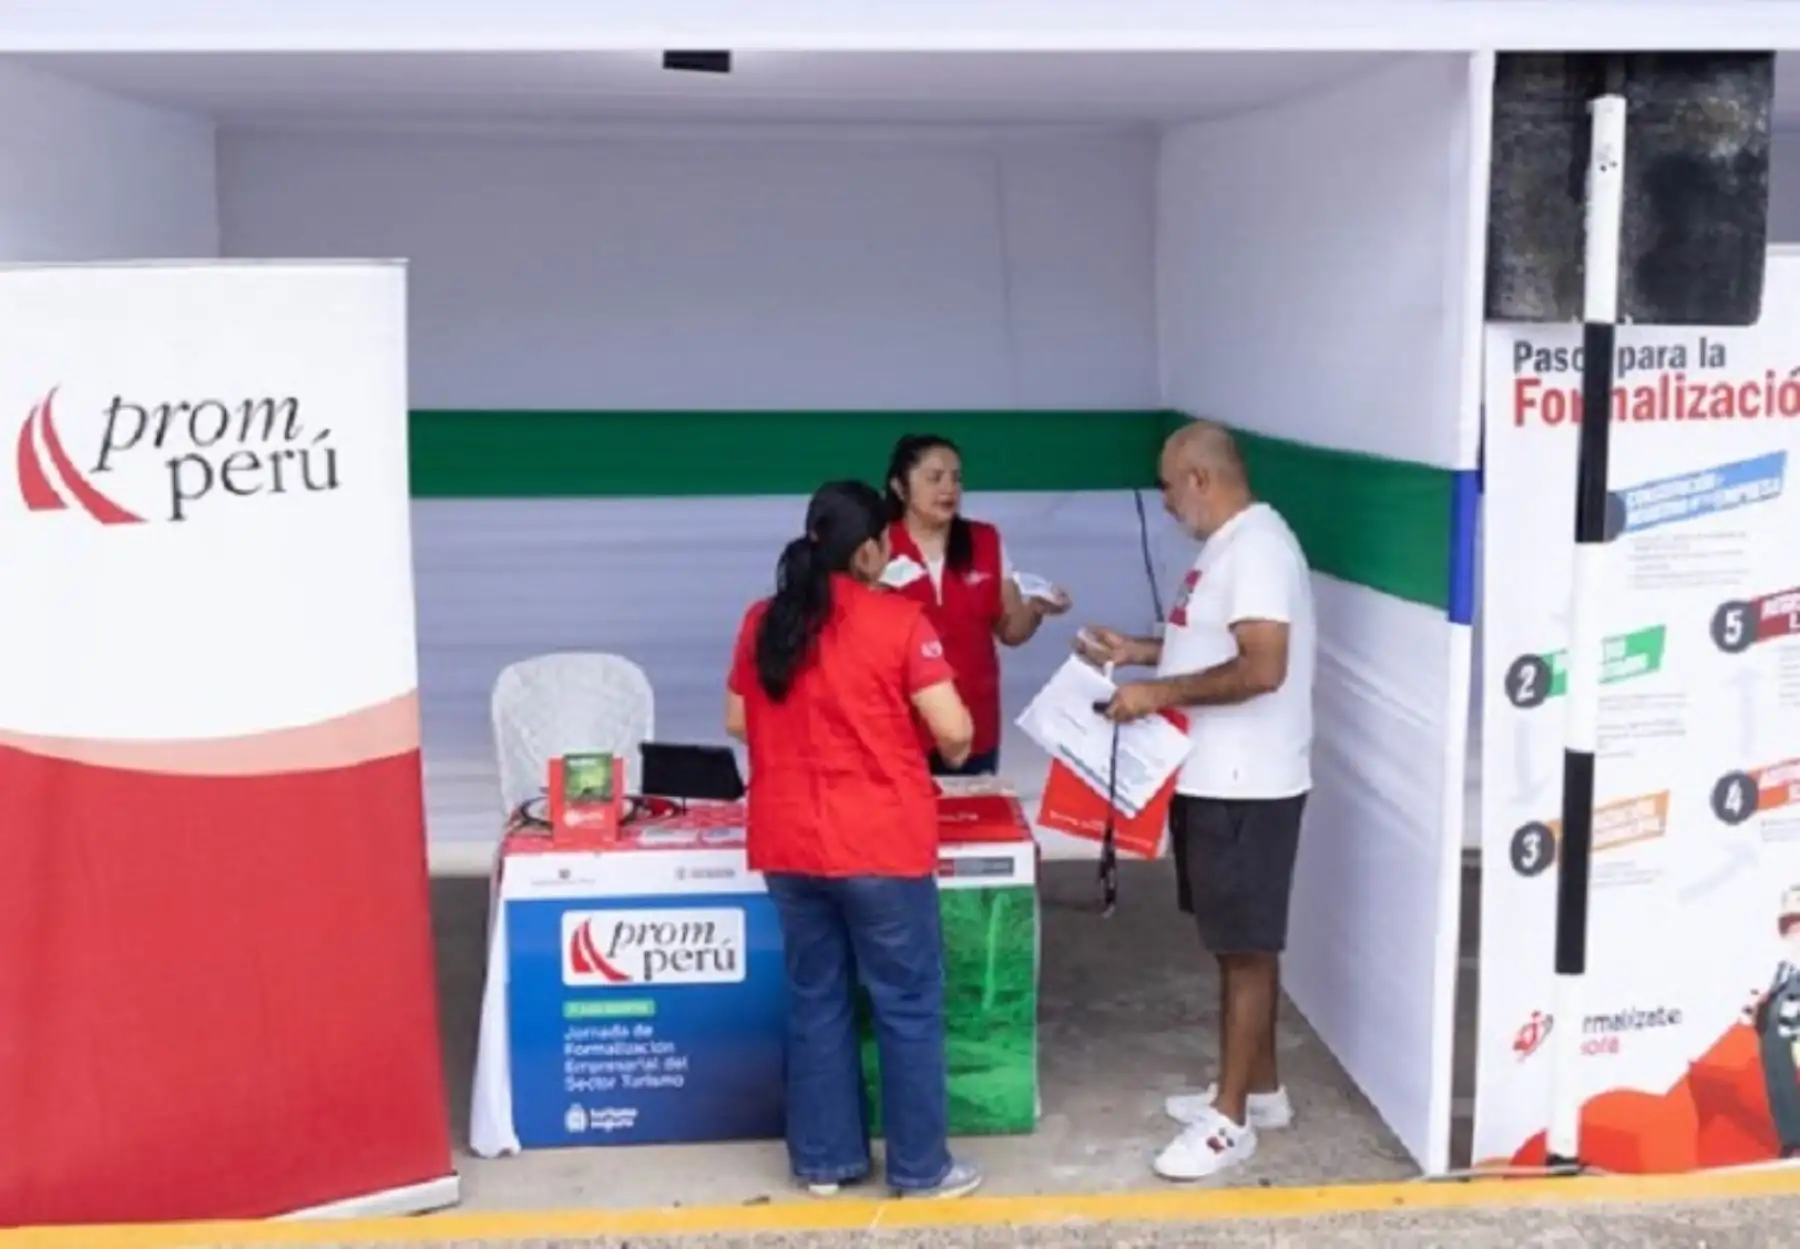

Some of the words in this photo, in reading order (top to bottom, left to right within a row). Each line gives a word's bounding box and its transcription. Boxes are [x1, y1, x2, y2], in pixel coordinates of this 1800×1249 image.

[1513, 339, 1584, 374] Paso
[1618, 345, 1687, 379] para
[1699, 337, 1726, 369] la
[88, 395, 303, 474] prom
[164, 428, 341, 522] perú
[1724, 608, 1744, 645] 5
[1516, 663, 1538, 704] 2
[1724, 779, 1742, 816] 4
[1521, 831, 1542, 869] 3
[606, 920, 716, 959] prom
[643, 938, 737, 982] perú
[632, 1023, 654, 1038] de
[564, 1074, 617, 1092] Sector
[621, 1073, 685, 1089] Turismo
